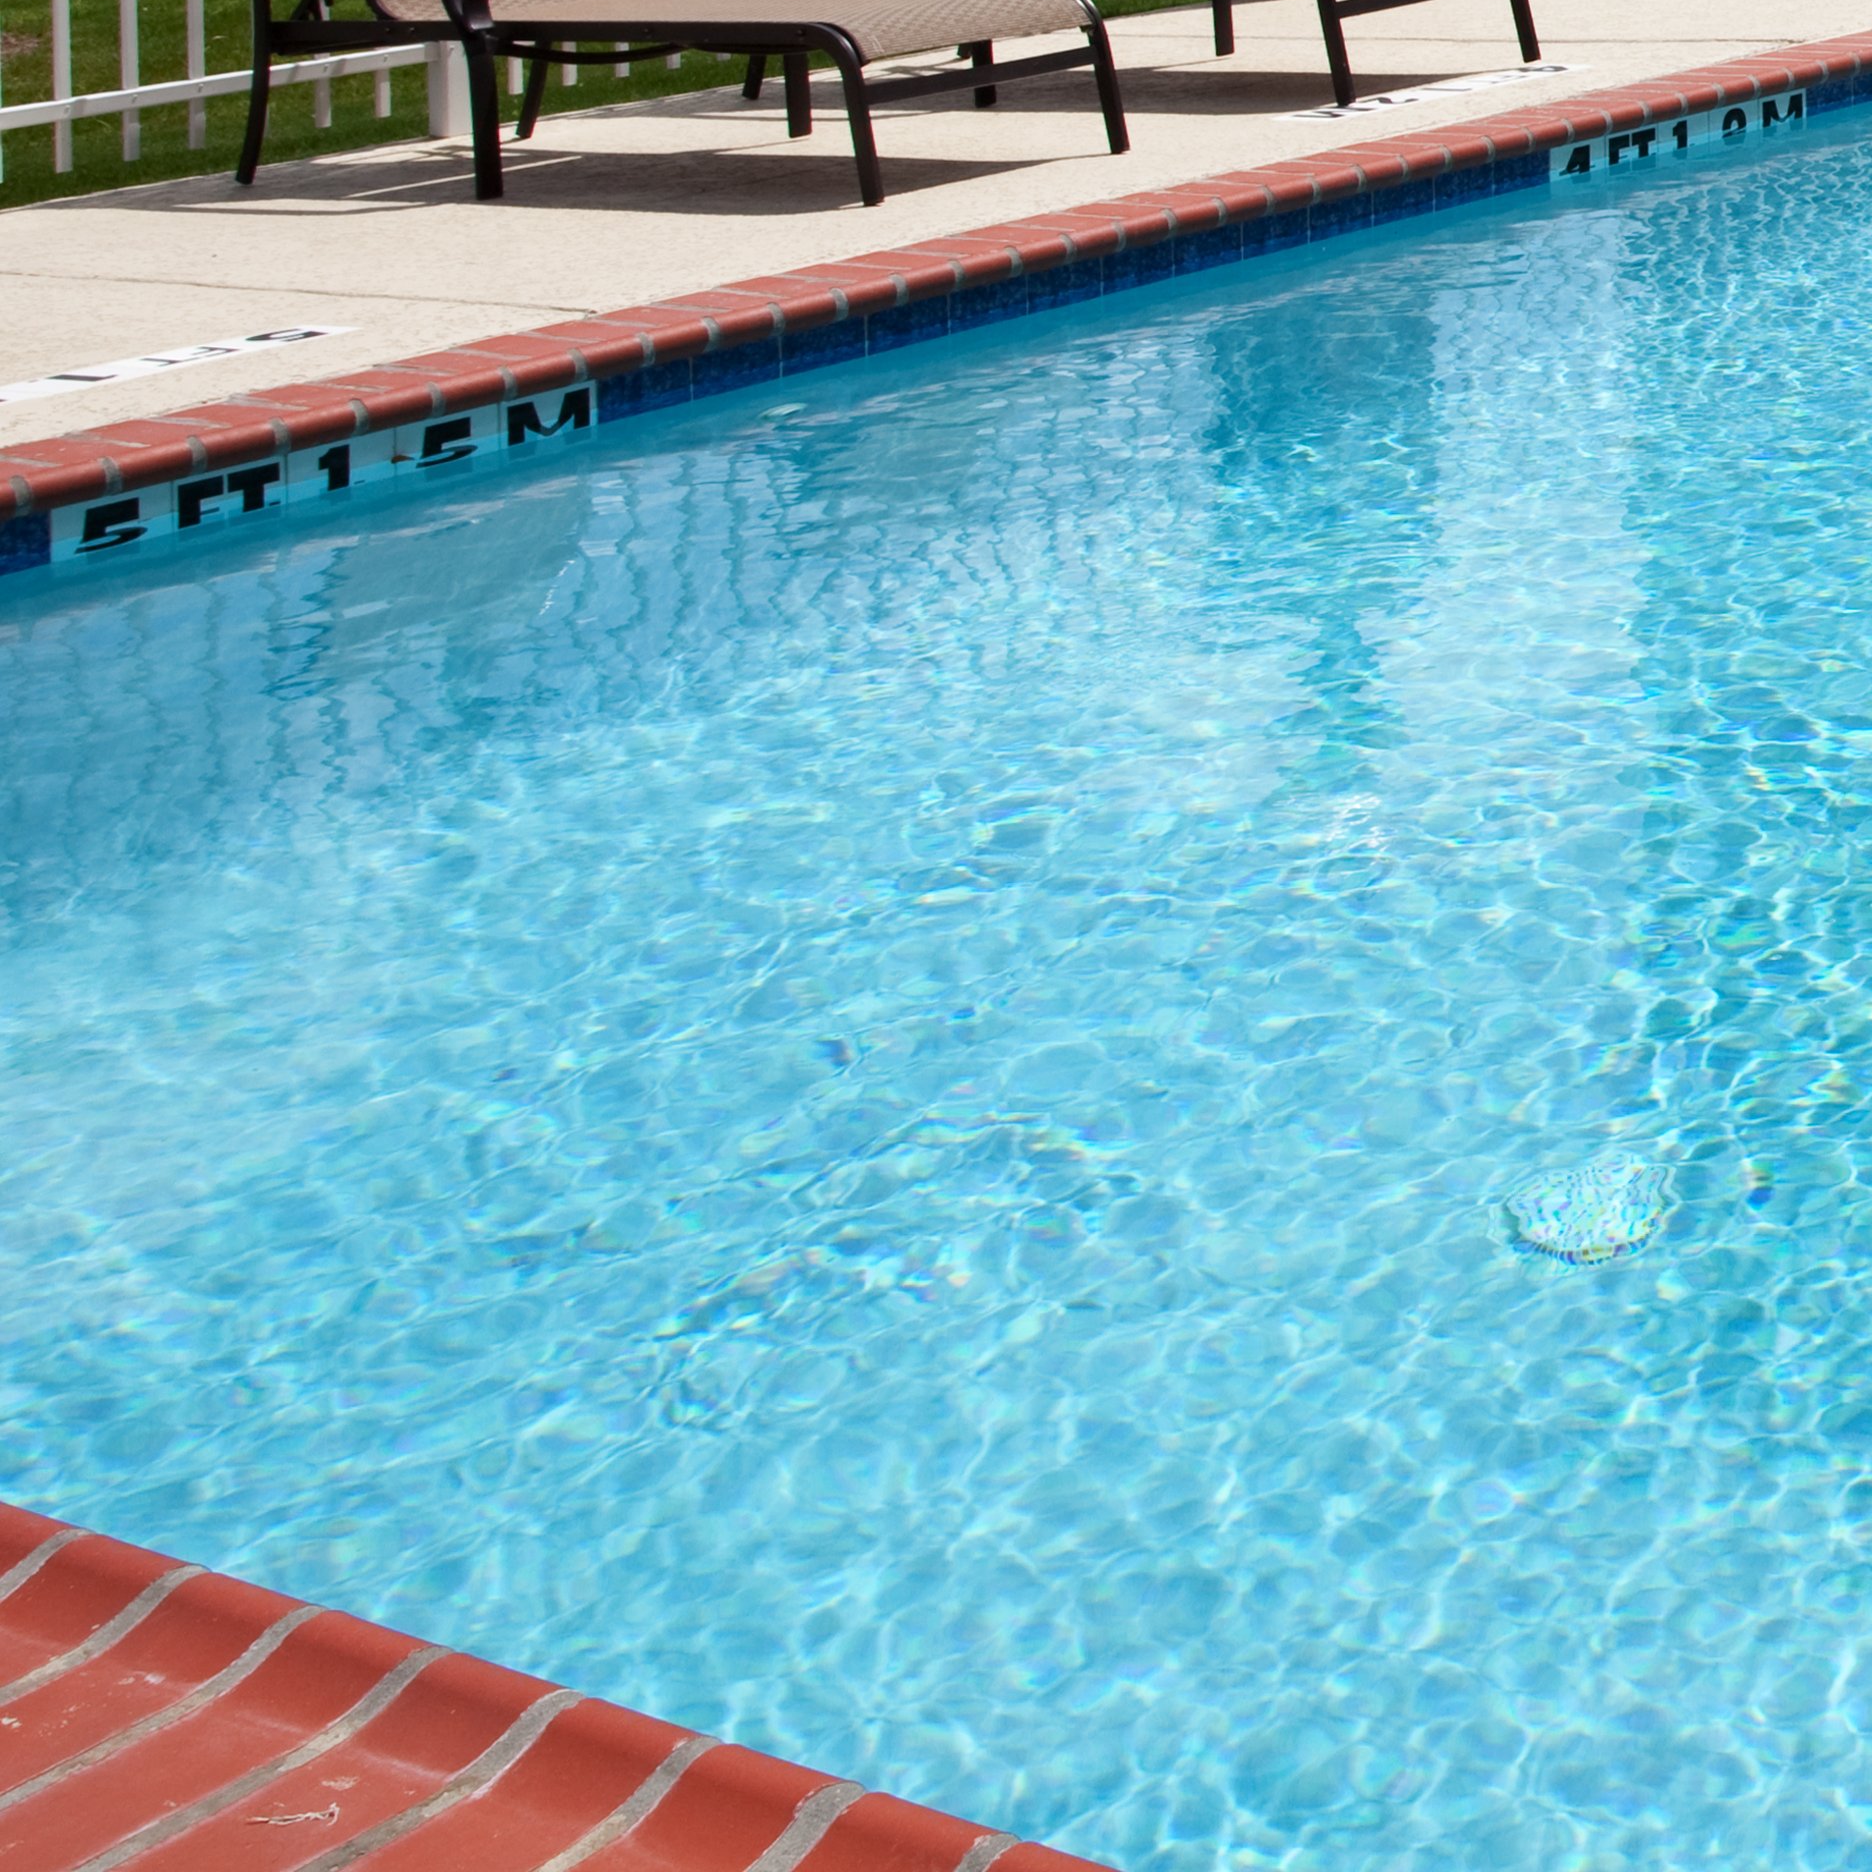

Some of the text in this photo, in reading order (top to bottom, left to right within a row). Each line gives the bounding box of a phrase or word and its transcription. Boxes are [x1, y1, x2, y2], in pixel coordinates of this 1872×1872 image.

[245, 328, 329, 342] 5
[140, 345, 241, 368] FT
[75, 497, 148, 554] 5
[507, 387, 590, 446] M
